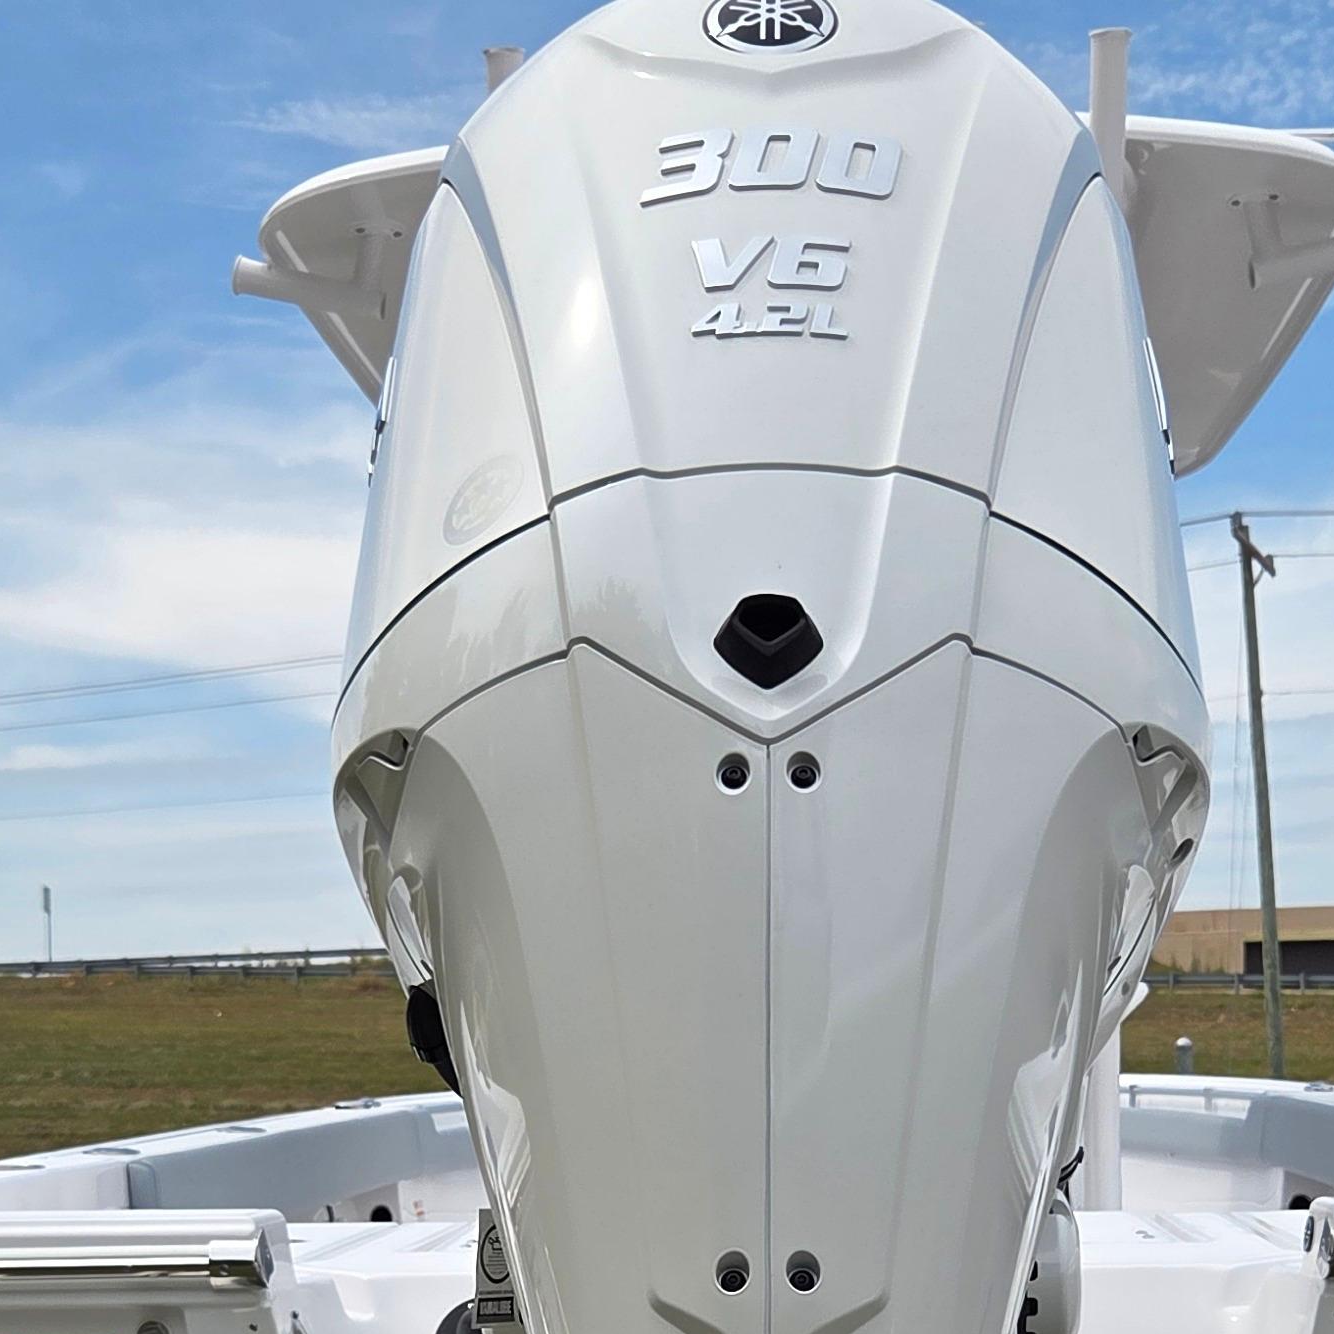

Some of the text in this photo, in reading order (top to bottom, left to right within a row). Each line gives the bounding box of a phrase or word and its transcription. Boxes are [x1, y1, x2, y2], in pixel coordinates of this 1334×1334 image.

[639, 127, 904, 207] 300
[690, 235, 853, 292] V6
[690, 302, 849, 340] 4.2L
